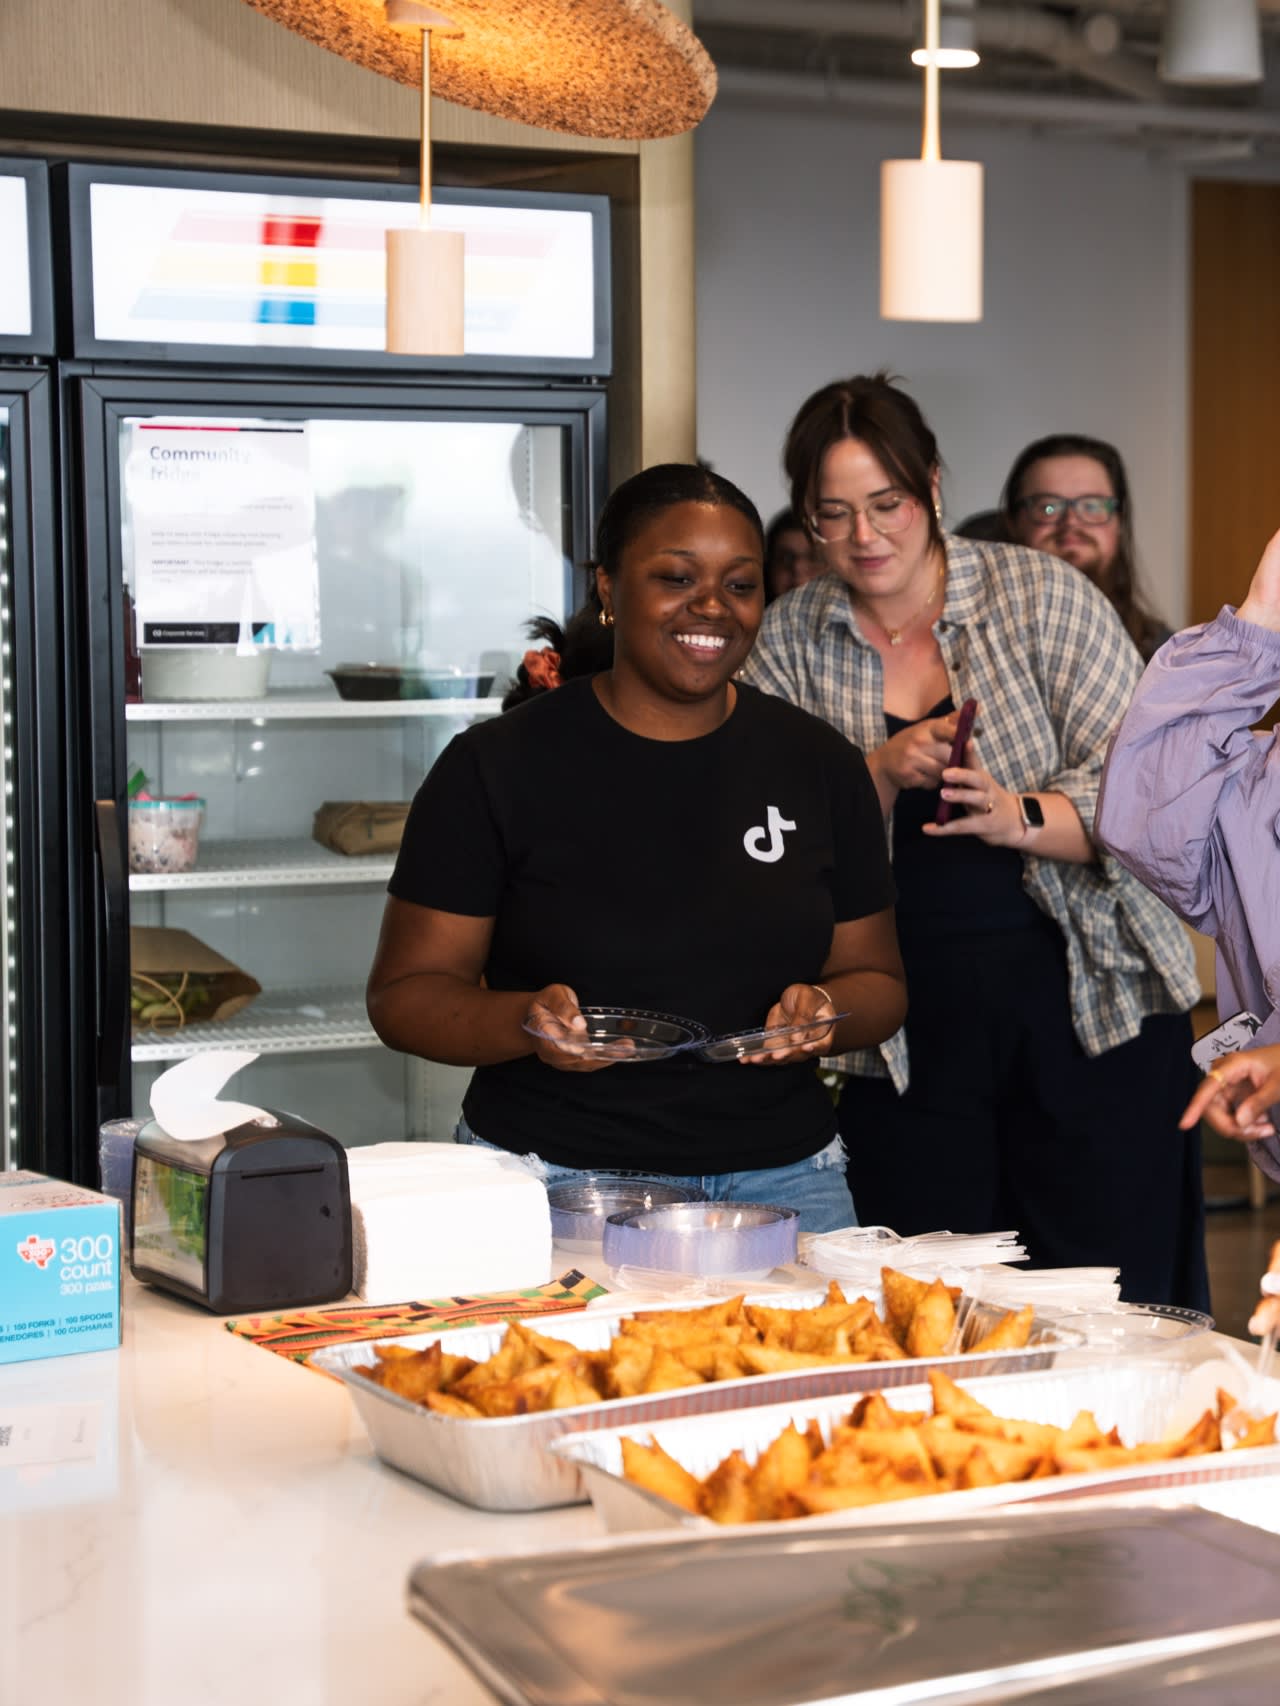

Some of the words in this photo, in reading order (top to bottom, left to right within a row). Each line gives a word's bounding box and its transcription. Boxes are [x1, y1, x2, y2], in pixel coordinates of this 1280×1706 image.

[150, 446, 250, 465] Community
[60, 1234, 113, 1264] 300
[60, 1260, 113, 1281] count
[28, 1319, 55, 1329] FORKS
[80, 1311, 113, 1322] SPOONS
[0, 1330, 44, 1343] ENEDORES
[68, 1321, 113, 1334] CUCHARAS
